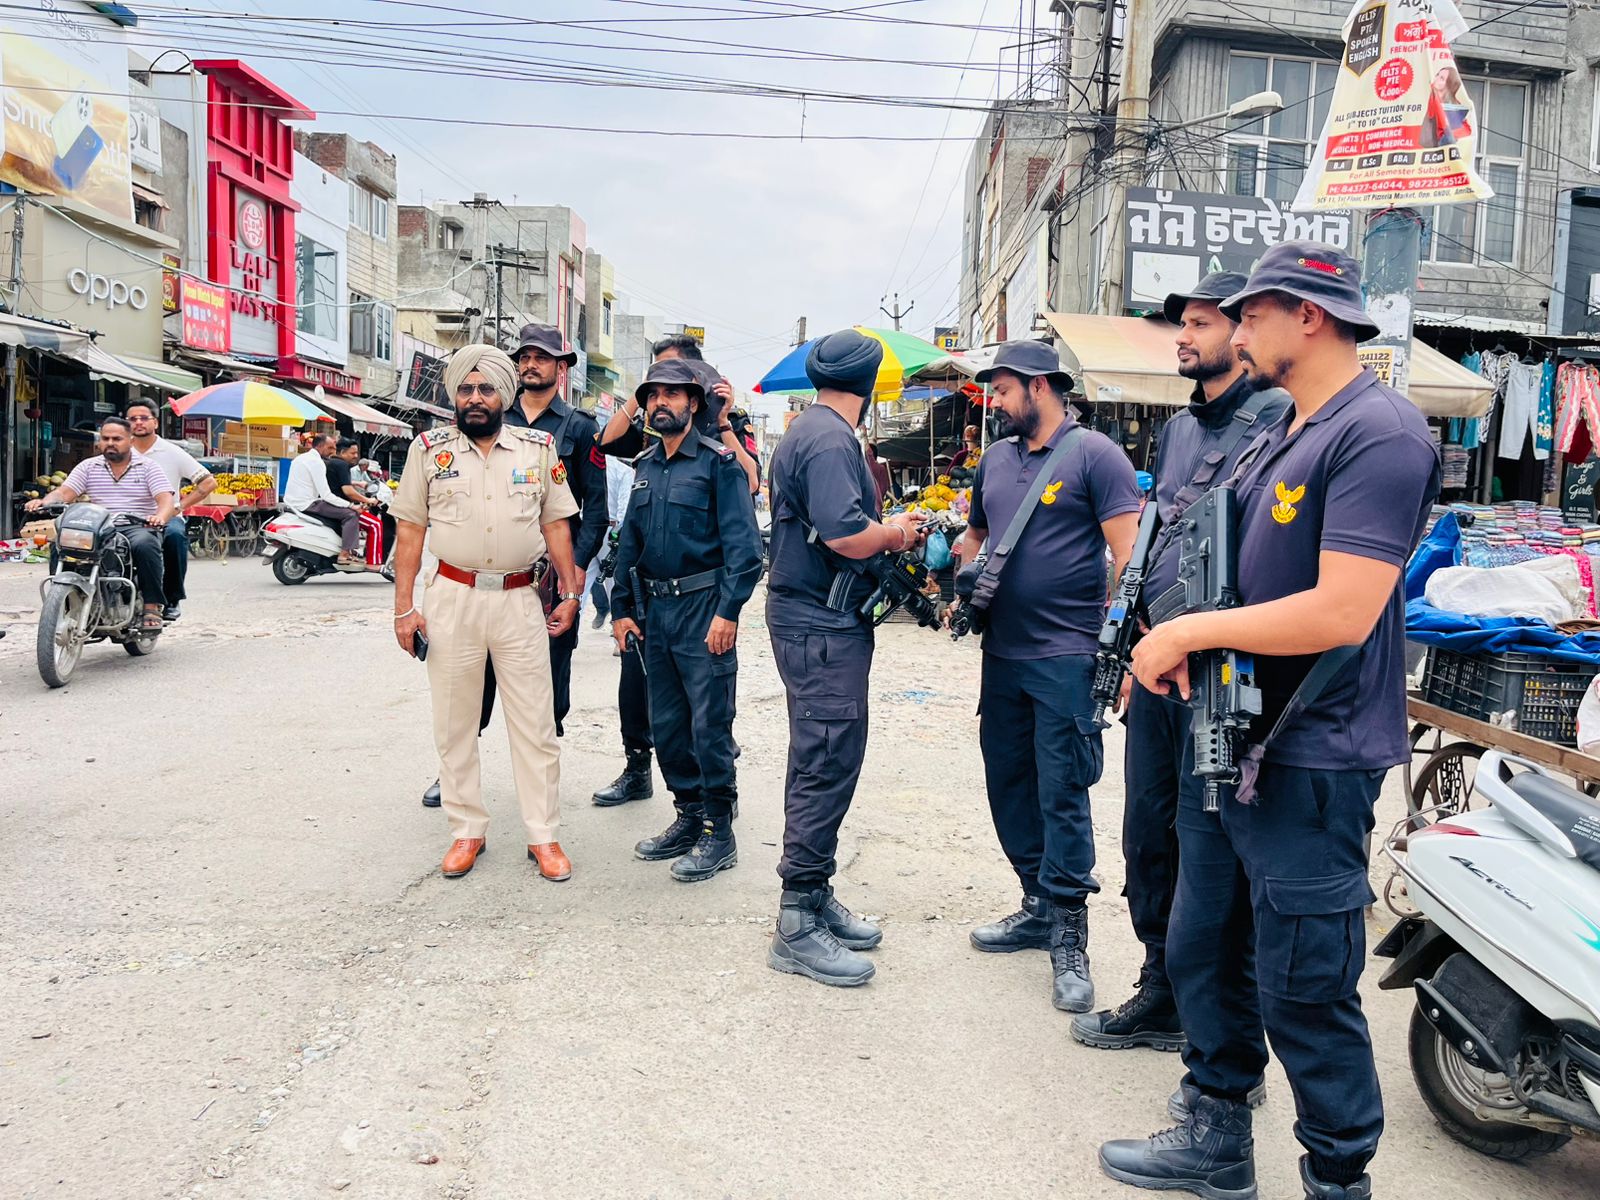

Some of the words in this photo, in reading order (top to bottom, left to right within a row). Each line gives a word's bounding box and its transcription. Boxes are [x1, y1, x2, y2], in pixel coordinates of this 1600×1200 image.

[1358, 9, 1376, 23] IELTS
[1360, 23, 1373, 35] PTE
[1350, 34, 1378, 50] SPOKEN
[1349, 47, 1379, 63] ENGLISH
[1390, 45, 1417, 54] FRENCH
[1381, 66, 1399, 77] IELTS
[1401, 66, 1408, 75] &
[1386, 76, 1399, 85] PTE
[1335, 115, 1344, 123] ALL
[1346, 108, 1377, 120] SUBJECTS
[1379, 105, 1404, 115] TUITION
[1407, 104, 1422, 112] FOR
[1357, 120, 1367, 128] TO
[1381, 115, 1403, 124] CLASS
[1365, 129, 1403, 140] COMMERCE
[1368, 139, 1414, 150] NON-MEDICAL
[1362, 158, 1377, 166] B.Sc
[1393, 154, 1408, 163] BBA
[1349, 172, 1363, 180] For
[1376, 168, 1414, 177] Semester
[1418, 166, 1451, 175] Subjects
[231, 247, 272, 279] LALI
[244, 274, 261, 297] DI
[304, 365, 322, 383] LALI
[325, 371, 333, 384] DI
[335, 373, 356, 392] HATTI
[1577, 474, 1587, 485] &
[1568, 484, 1593, 500] Girls
